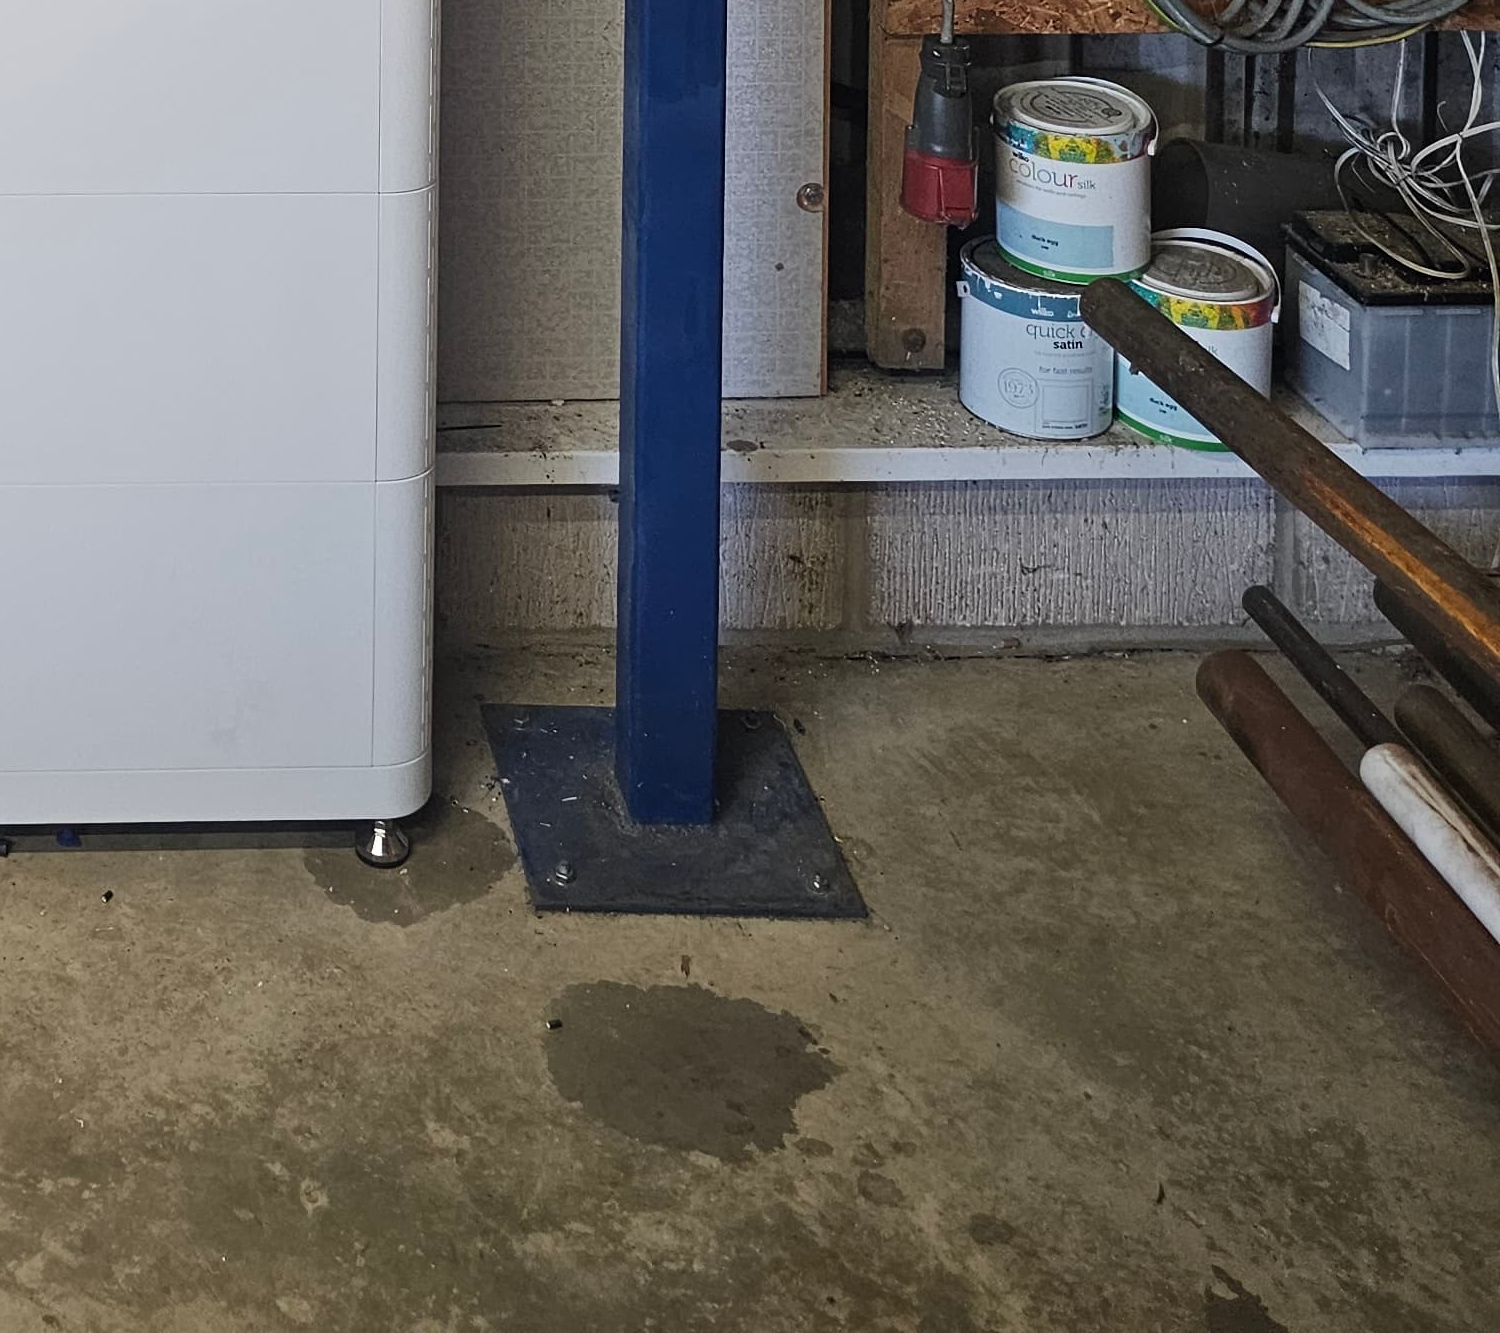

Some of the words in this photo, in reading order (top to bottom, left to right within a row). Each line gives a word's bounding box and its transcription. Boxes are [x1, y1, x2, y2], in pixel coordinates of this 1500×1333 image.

[1009, 157, 1078, 189] colour
[1077, 180, 1097, 190] silk
[1026, 323, 1076, 340] quick
[1053, 339, 1084, 351] satin
